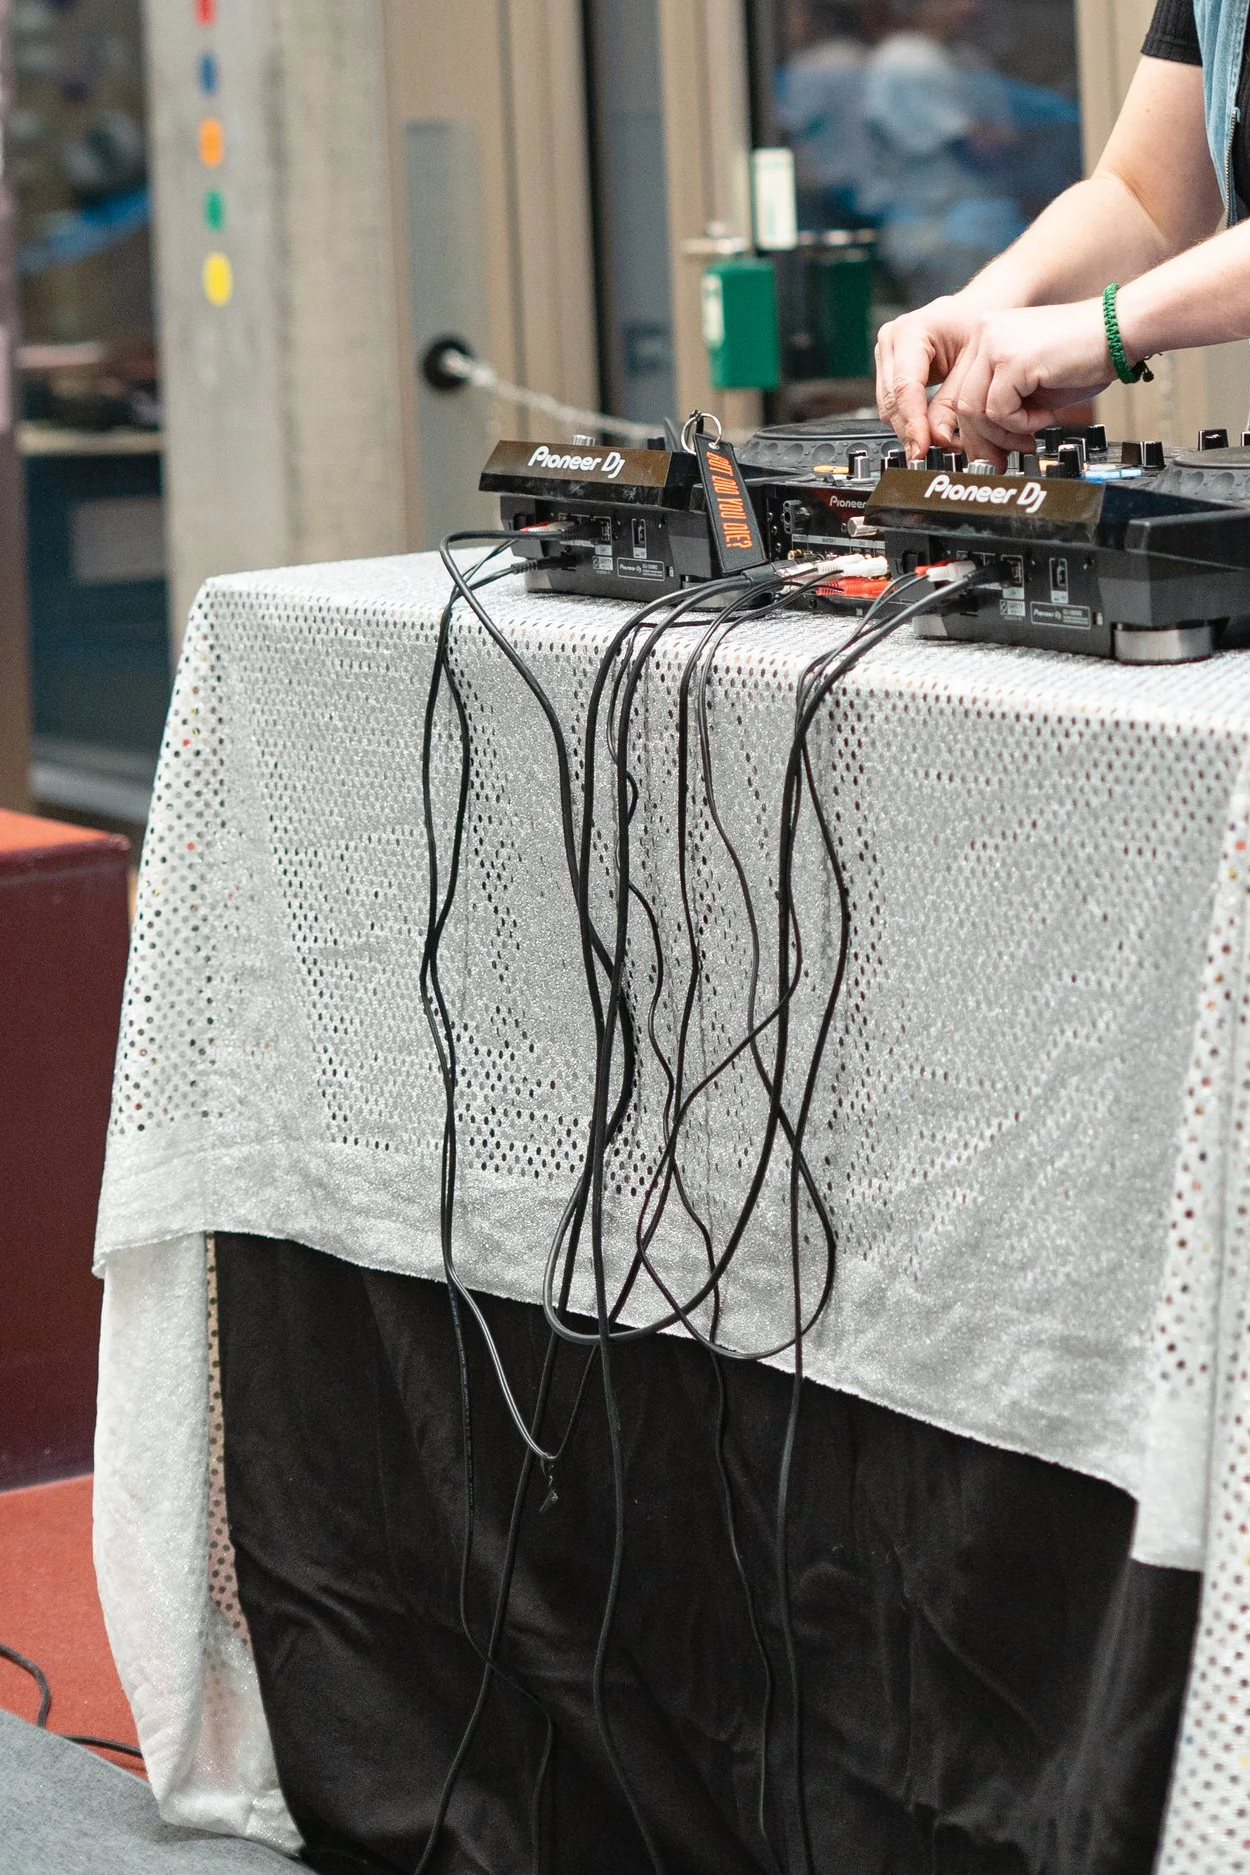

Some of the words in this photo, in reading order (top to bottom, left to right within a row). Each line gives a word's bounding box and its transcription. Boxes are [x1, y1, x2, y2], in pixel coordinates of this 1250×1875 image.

[528, 445, 602, 471] Pioneer
[706, 451, 734, 477] BUT
[711, 475, 740, 495] DID
[924, 474, 1018, 504] Pioneer
[717, 498, 747, 519] YOU
[829, 495, 867, 509] Pioneer
[723, 523, 753, 548] DIE?
